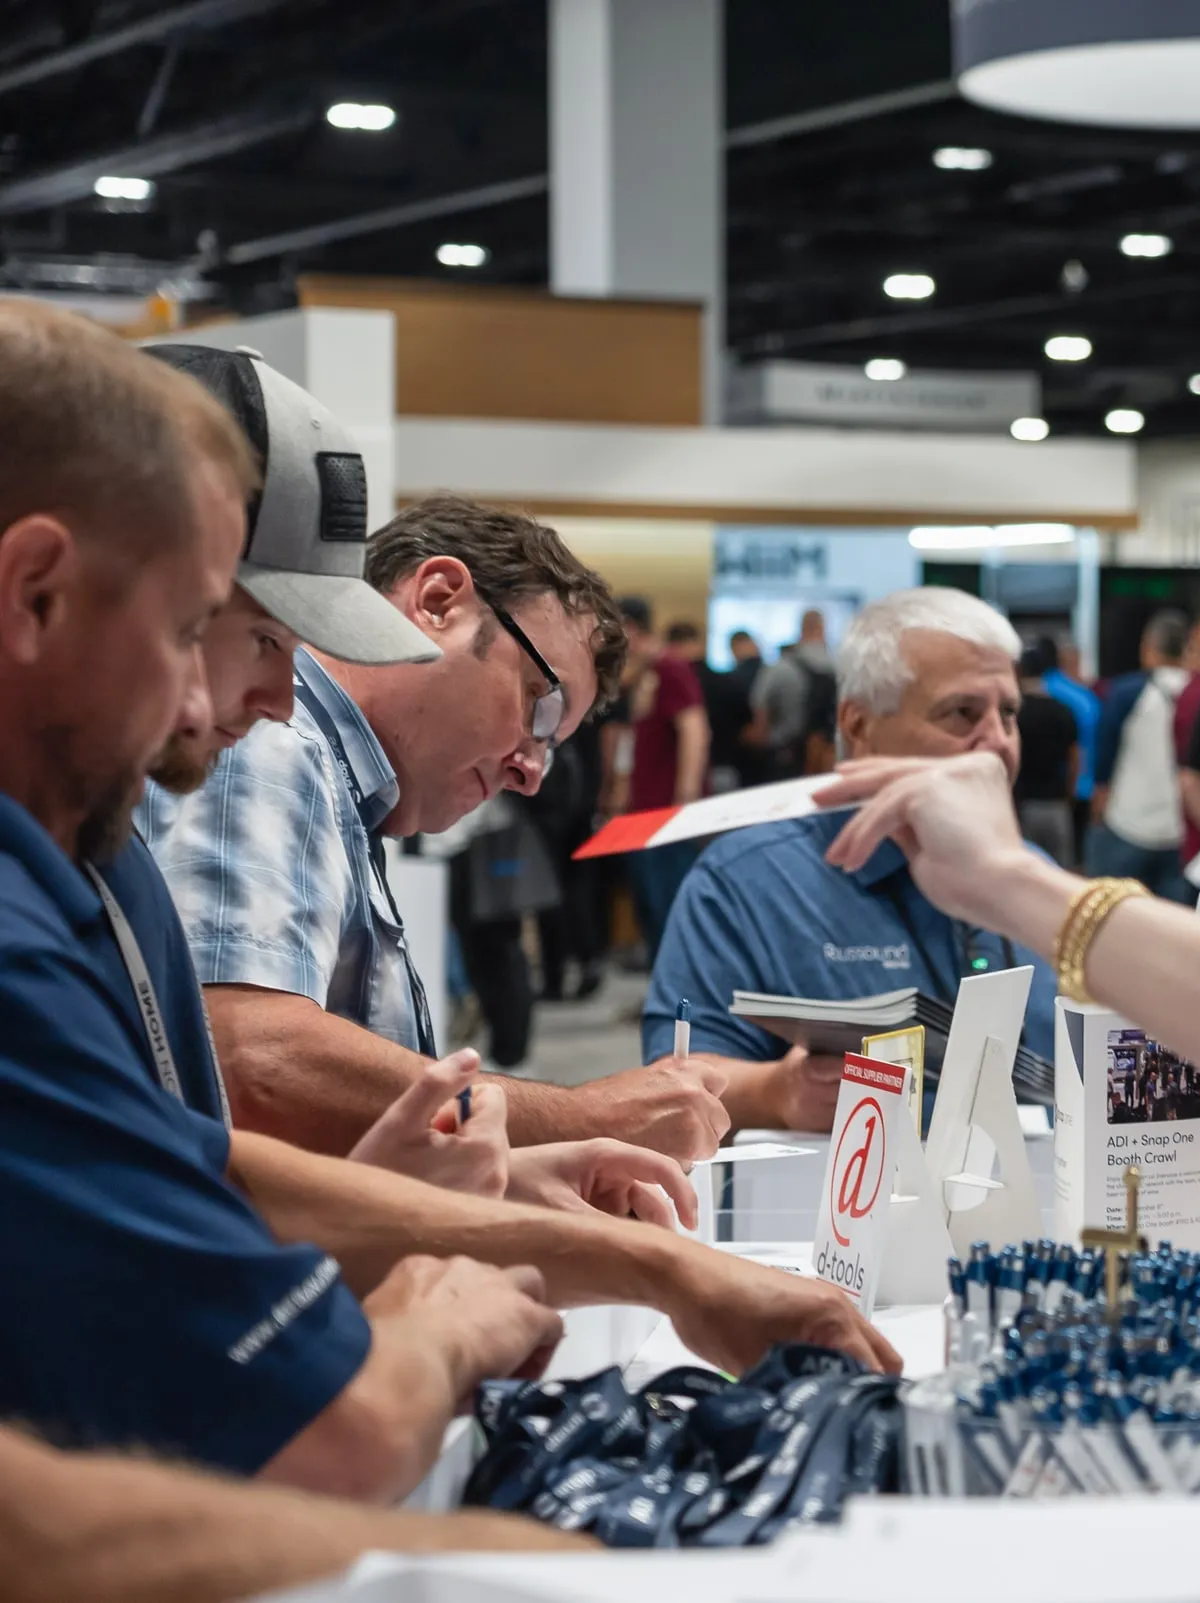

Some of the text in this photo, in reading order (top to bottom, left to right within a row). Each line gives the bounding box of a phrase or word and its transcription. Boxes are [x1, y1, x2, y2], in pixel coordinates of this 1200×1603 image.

[138, 979, 167, 1052] HOME
[1107, 1136, 1128, 1148] ADI
[1141, 1134, 1170, 1147] Snap
[1172, 1132, 1194, 1143] One
[1107, 1150, 1177, 1166] Booth Crawl
[817, 1241, 865, 1290] d-tools
